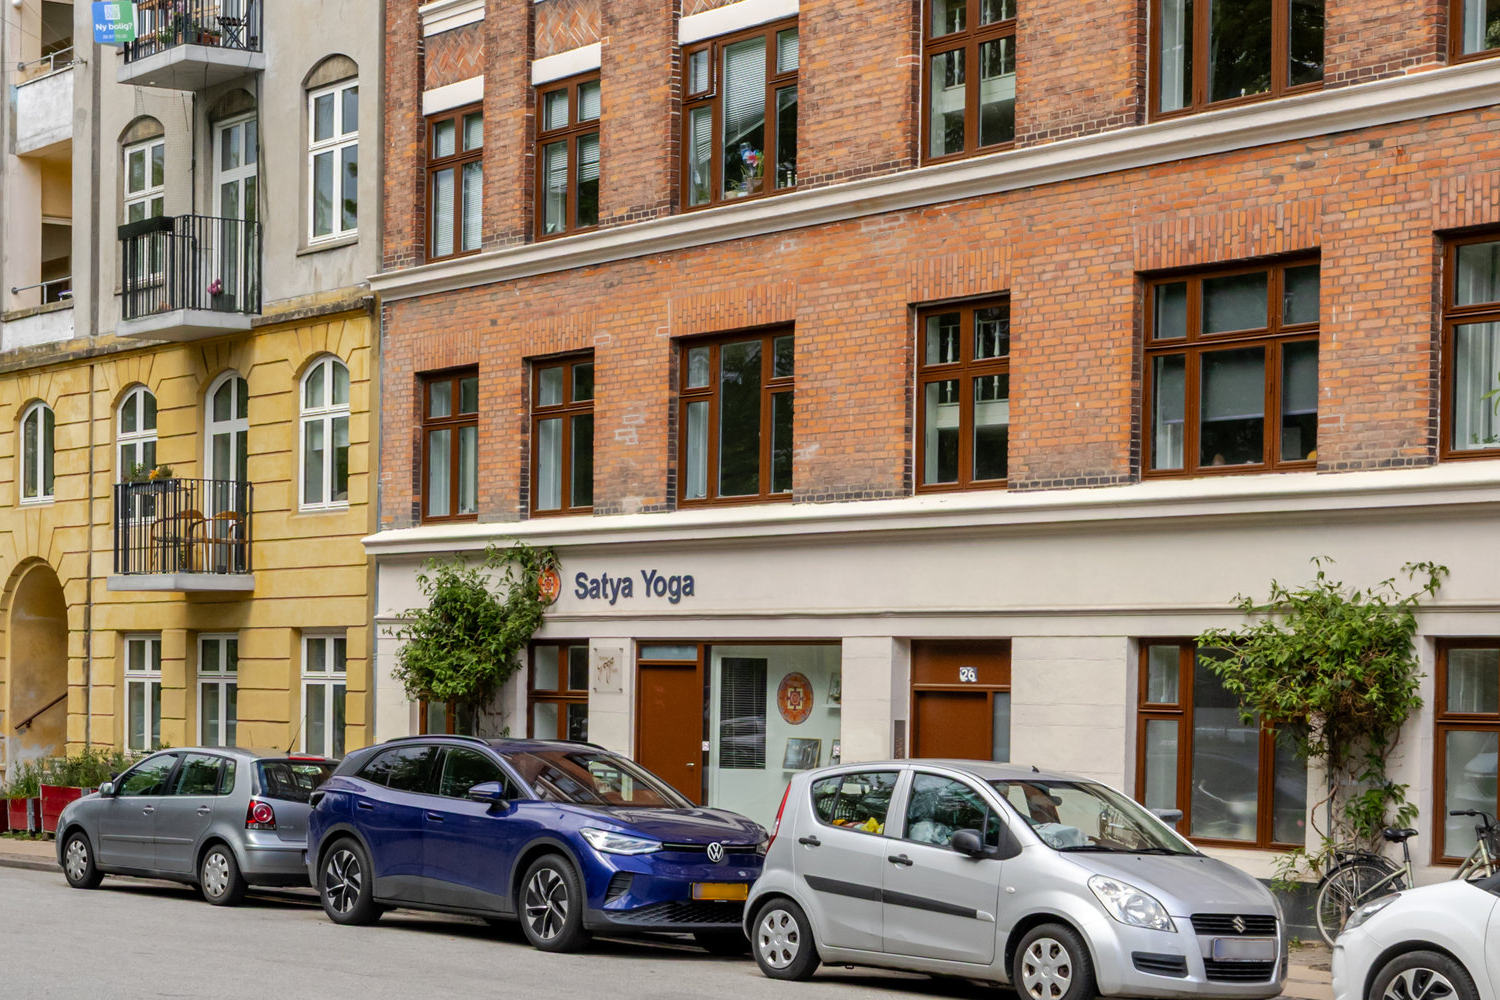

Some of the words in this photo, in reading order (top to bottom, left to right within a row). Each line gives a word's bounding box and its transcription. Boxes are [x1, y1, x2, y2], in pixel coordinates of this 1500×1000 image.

[95, 23, 107, 32] Ny
[108, 22, 133, 32] bolig?
[574, 572, 634, 606] Satya
[640, 569, 695, 605] Yoga
[961, 669, 976, 681] 26
